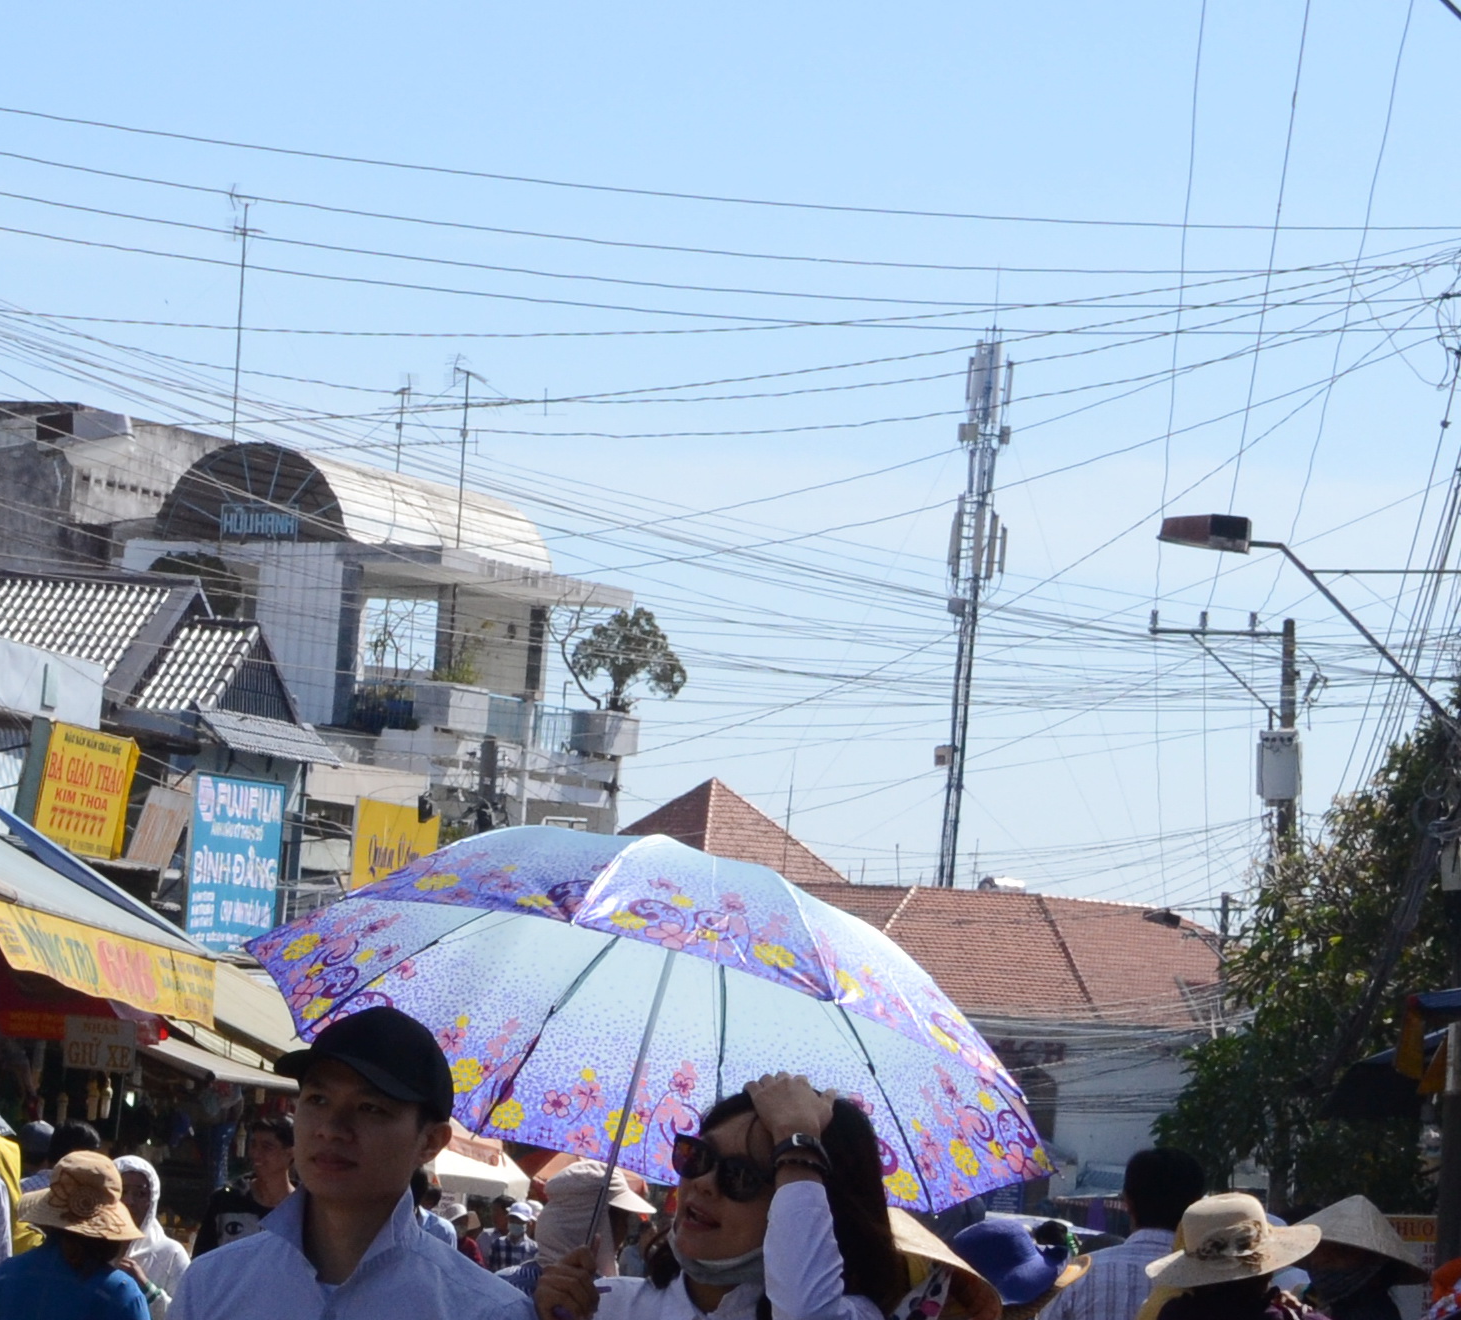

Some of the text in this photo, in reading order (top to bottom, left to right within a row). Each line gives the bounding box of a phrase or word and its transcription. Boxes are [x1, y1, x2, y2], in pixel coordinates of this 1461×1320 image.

[48, 746, 65, 780] BÀ
[66, 752, 94, 788] GIÁO
[55, 786, 108, 812] KIM THOA
[216, 782, 281, 823] FUJIFILM
[105, 1045, 131, 1069] XE
